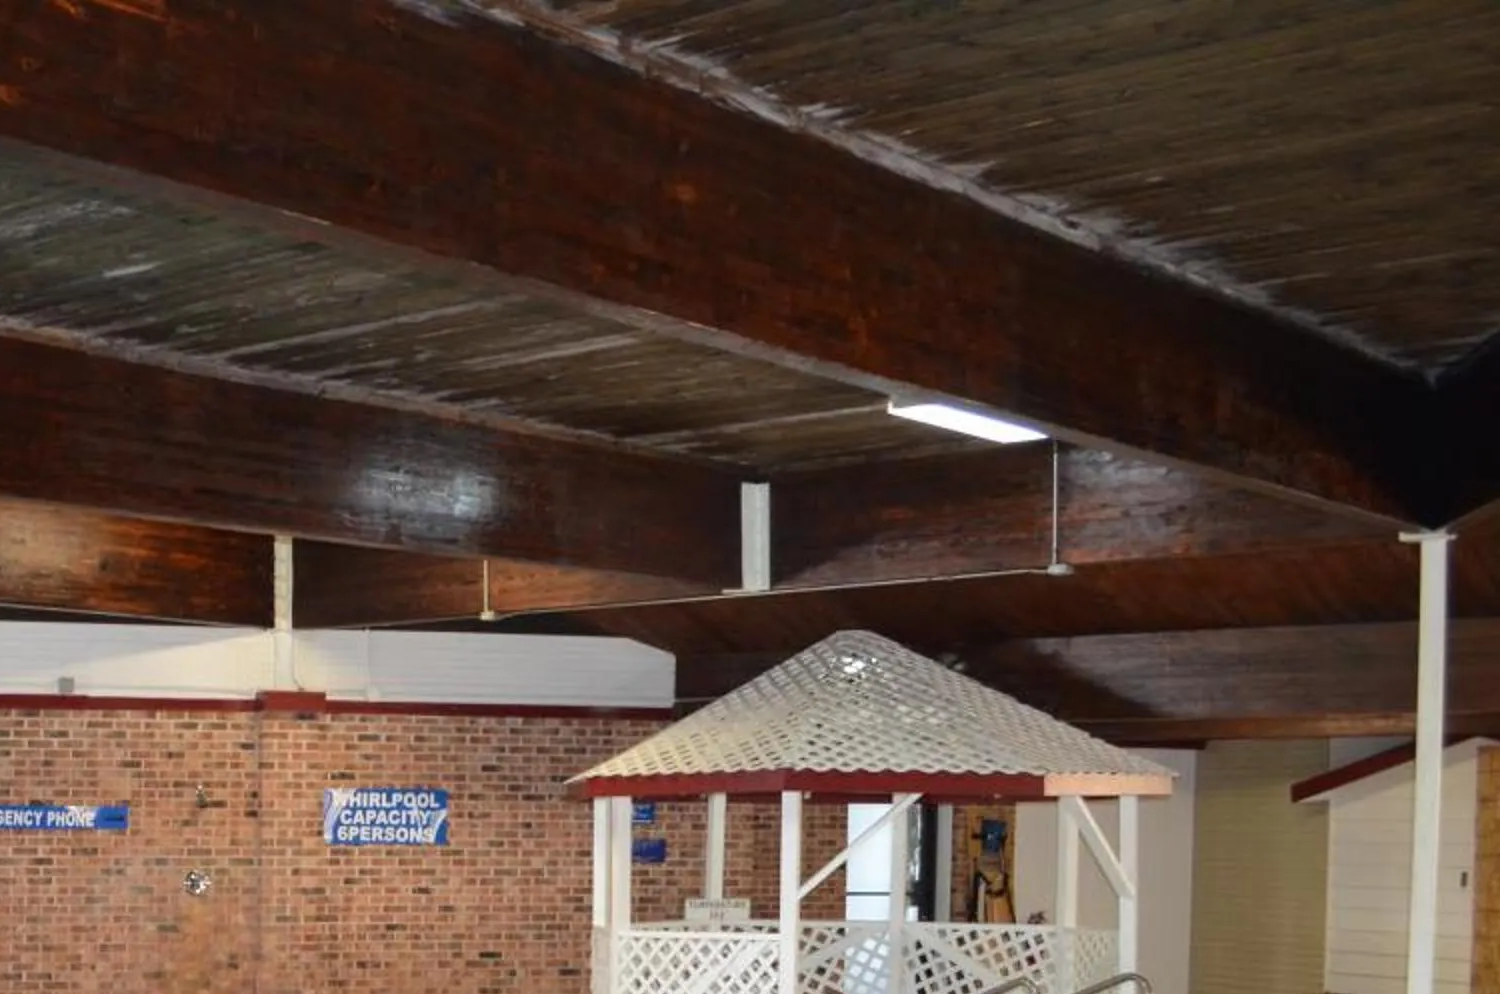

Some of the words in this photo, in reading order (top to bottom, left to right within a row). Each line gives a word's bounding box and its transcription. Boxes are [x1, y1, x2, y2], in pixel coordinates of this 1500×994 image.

[332, 791, 440, 808] WHIRLPOOL
[47, 808, 96, 826] PHONE
[340, 809, 431, 825] CAPACITY
